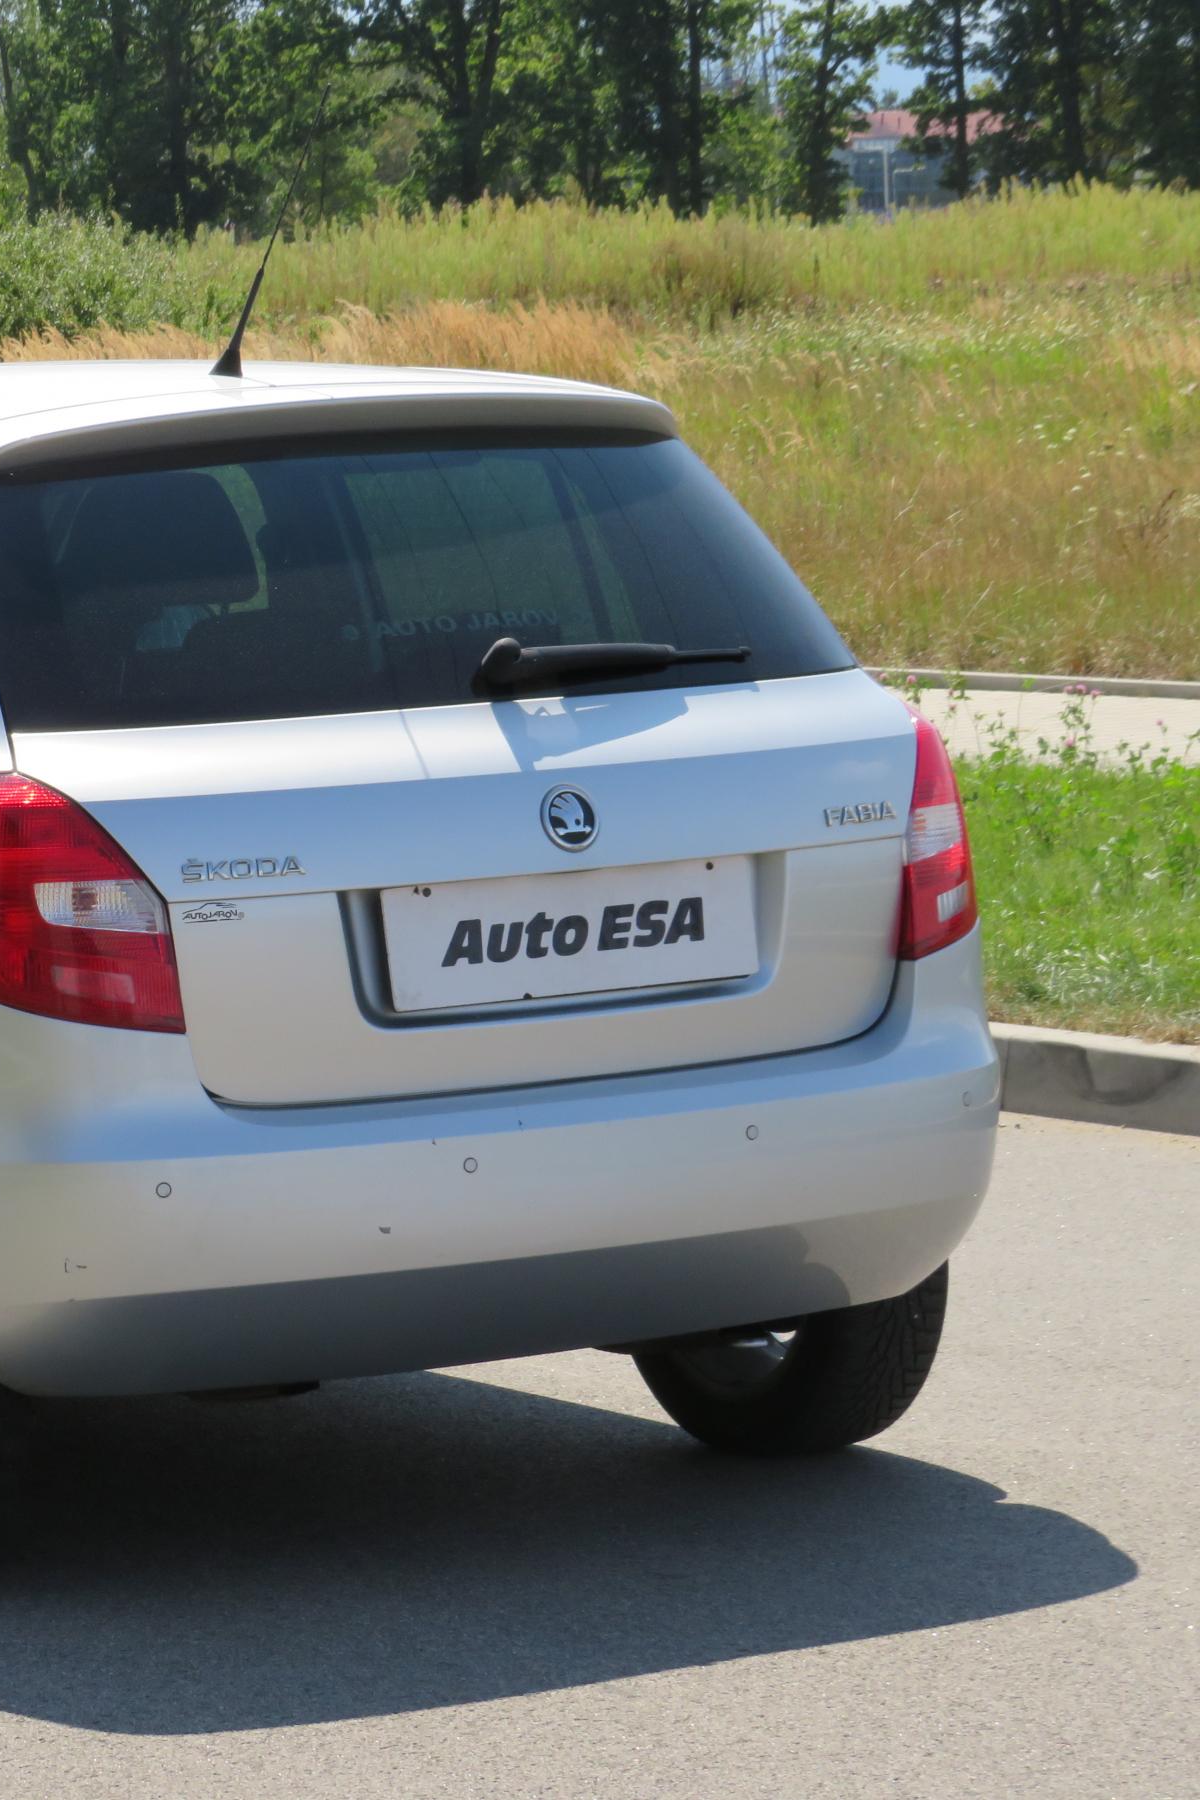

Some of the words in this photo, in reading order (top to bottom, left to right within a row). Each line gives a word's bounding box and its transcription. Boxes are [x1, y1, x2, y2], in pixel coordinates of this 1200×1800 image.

[823, 800, 897, 828] FABIA
[181, 855, 306, 884] ŠKODA
[441, 911, 589, 968] Auto
[597, 896, 705, 951] ESA
